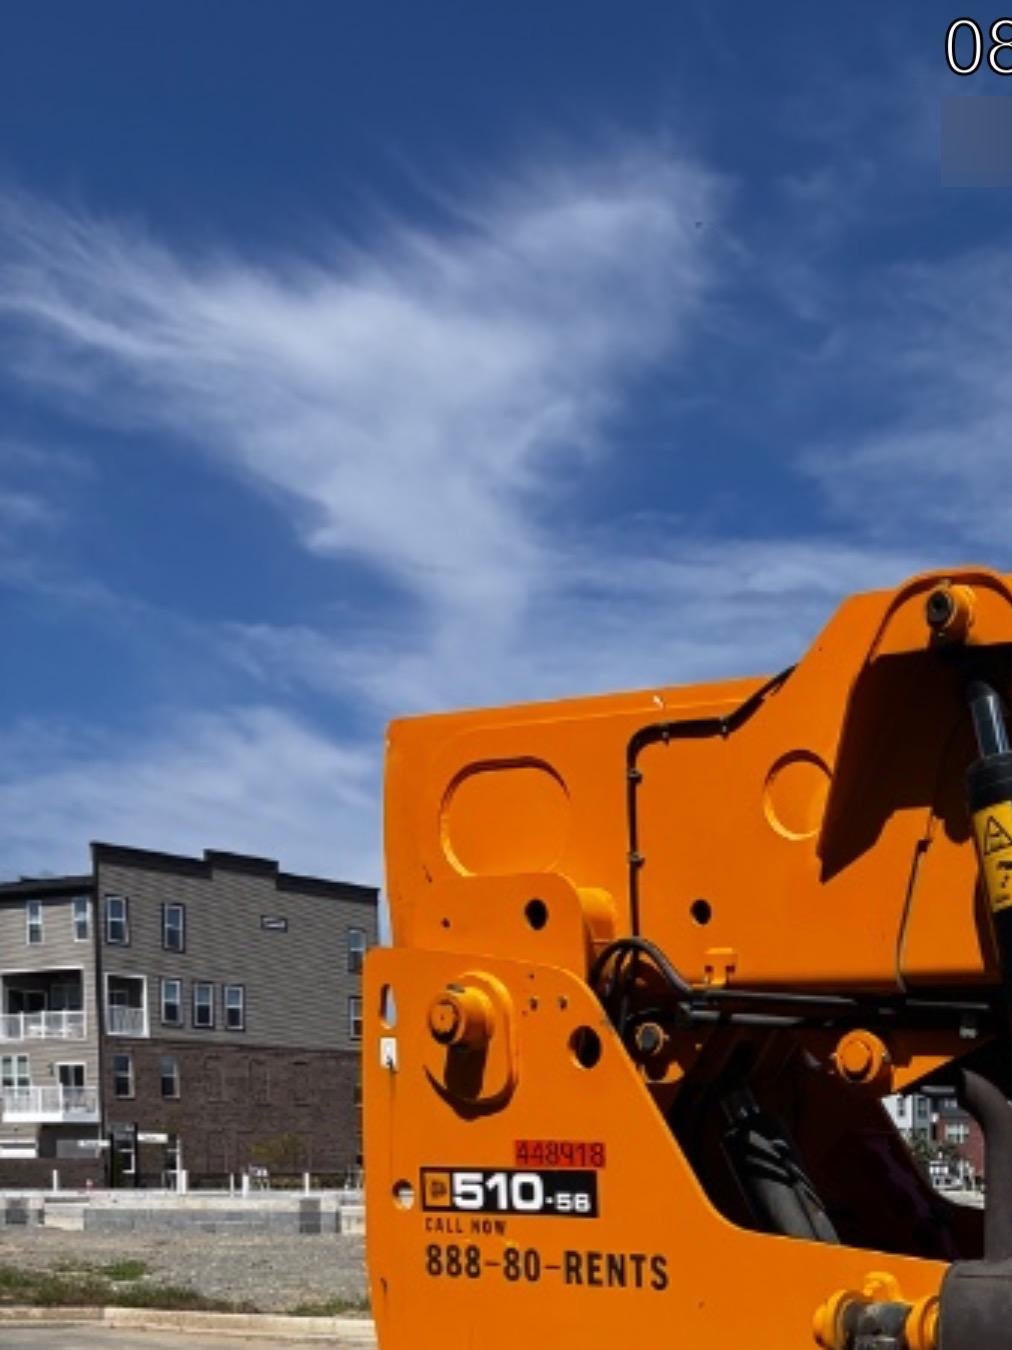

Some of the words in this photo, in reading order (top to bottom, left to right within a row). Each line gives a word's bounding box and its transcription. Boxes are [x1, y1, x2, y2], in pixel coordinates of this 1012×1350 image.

[424, 1217, 463, 1233] CALL
[471, 1219, 506, 1235] NOW
[426, 1244, 669, 1290] 888-80-RENTS
